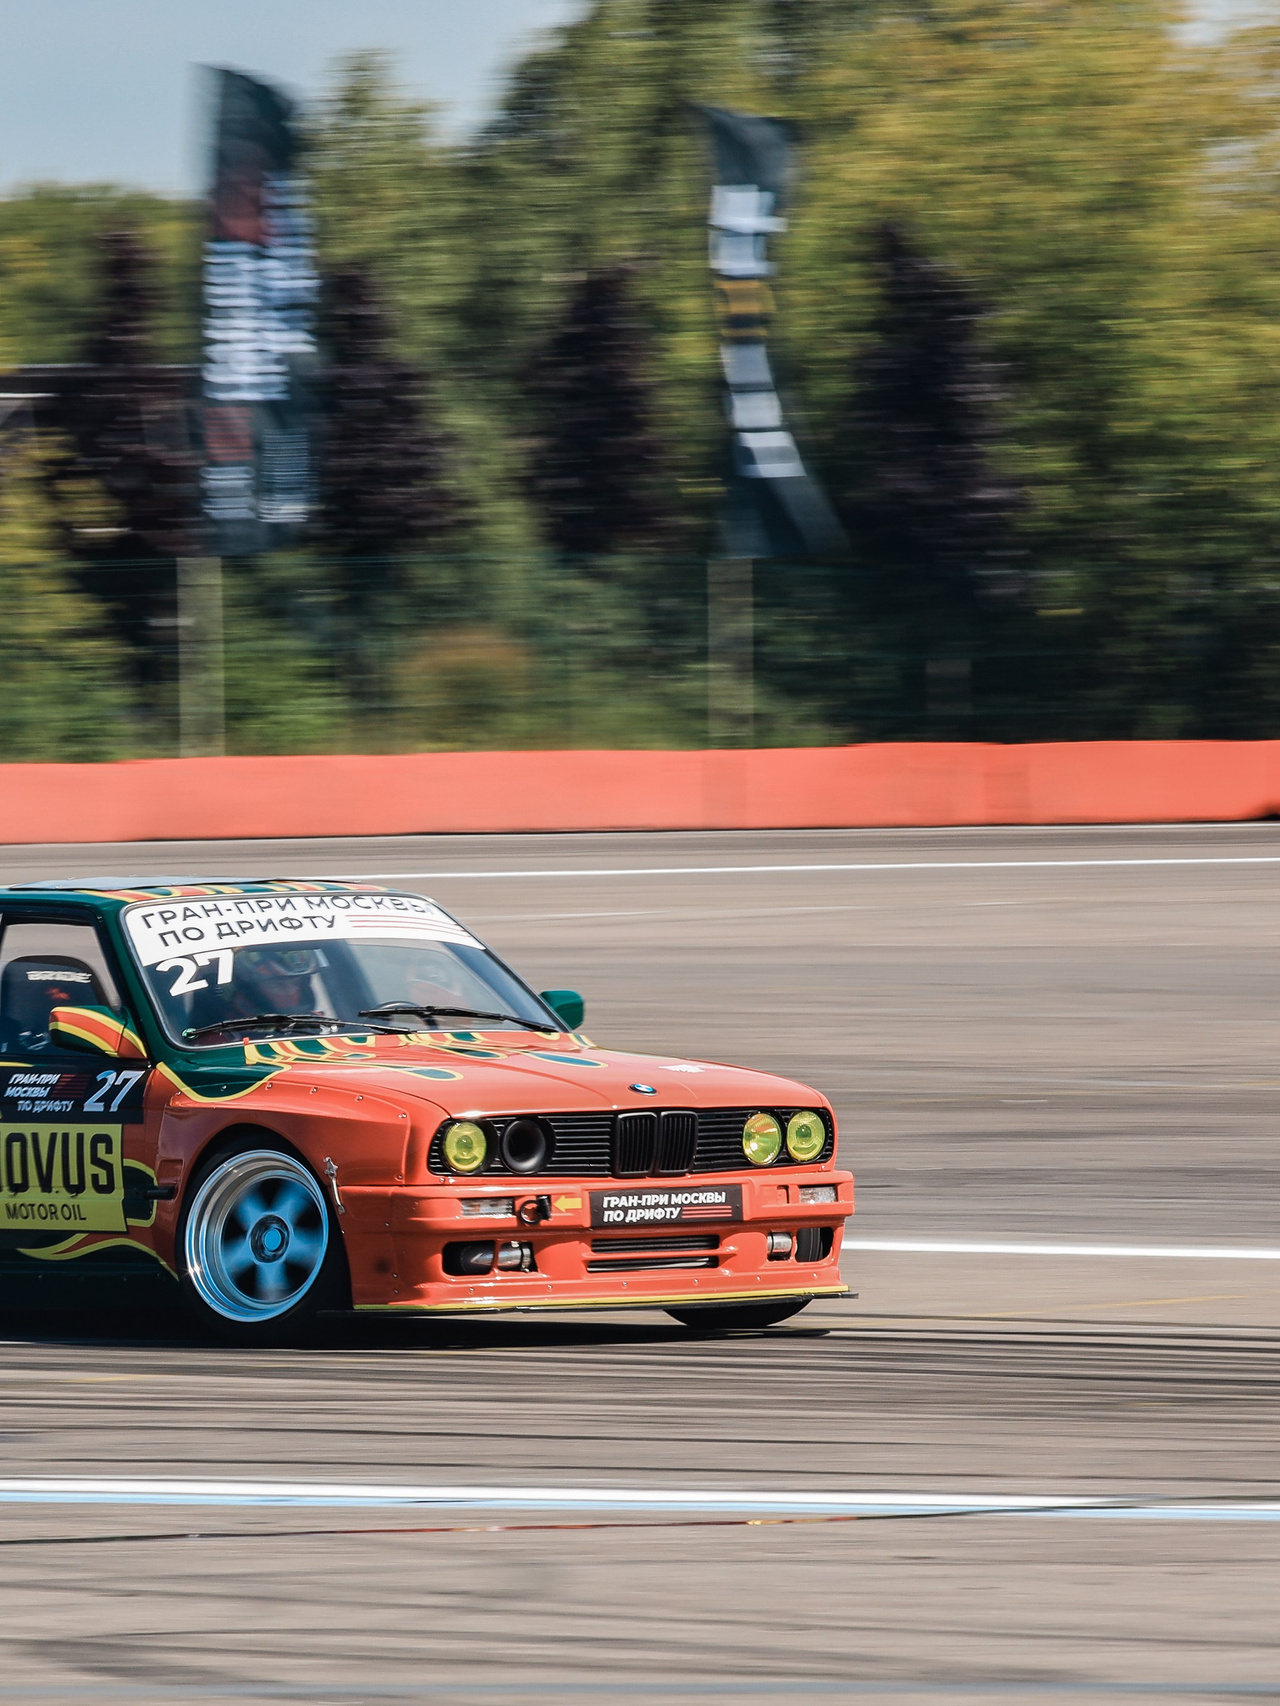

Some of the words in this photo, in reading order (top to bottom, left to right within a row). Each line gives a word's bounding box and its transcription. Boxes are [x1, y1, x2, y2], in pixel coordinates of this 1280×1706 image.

[141, 898, 297, 929] ГРАН-ПРИ
[158, 926, 205, 947] ПО
[215, 915, 335, 940] ДРИФТУ
[156, 948, 234, 997] 27
[8, 1073, 61, 1085] ГРАН-ПРИ
[3, 1086, 51, 1098] МОСКВЫ
[83, 1069, 145, 1112] 27
[17, 1100, 32, 1112] ПО
[32, 1100, 74, 1114] ДРИФТУ
[602, 1194, 669, 1208] ГРАН-ПРИ
[670, 1191, 726, 1204] МОСКВЫ
[5, 1203, 62, 1221] MOTOR
[62, 1204, 87, 1221] OIL
[602, 1210, 624, 1222] ПО
[624, 1207, 681, 1222] ДРИФТУ
